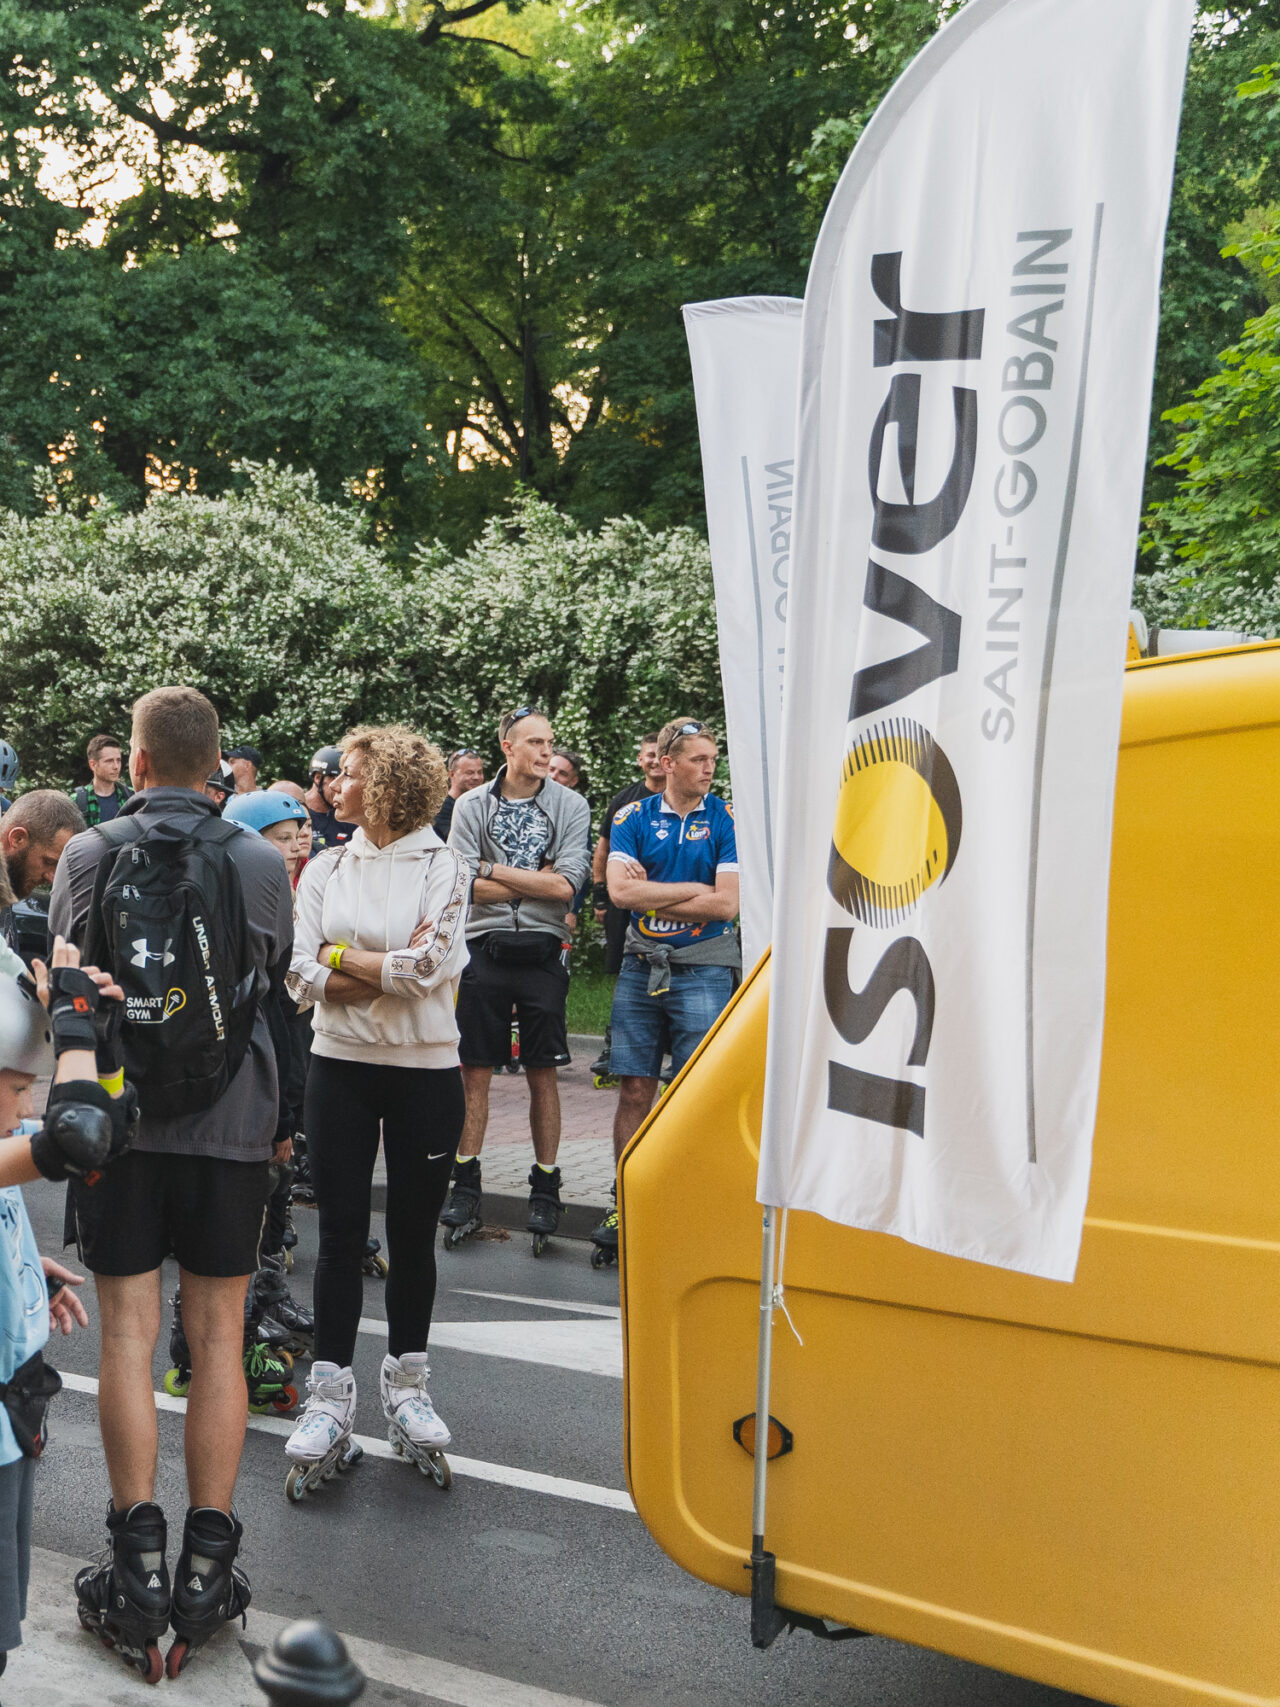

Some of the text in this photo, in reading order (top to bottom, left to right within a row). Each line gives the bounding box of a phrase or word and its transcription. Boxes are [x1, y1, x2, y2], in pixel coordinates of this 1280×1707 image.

[981, 227, 1074, 745] SAINT-GOBAIN
[126, 997, 163, 1008] SMART
[192, 916, 225, 1041] UNDER ARMOUR
[126, 1009, 151, 1020] GYM
